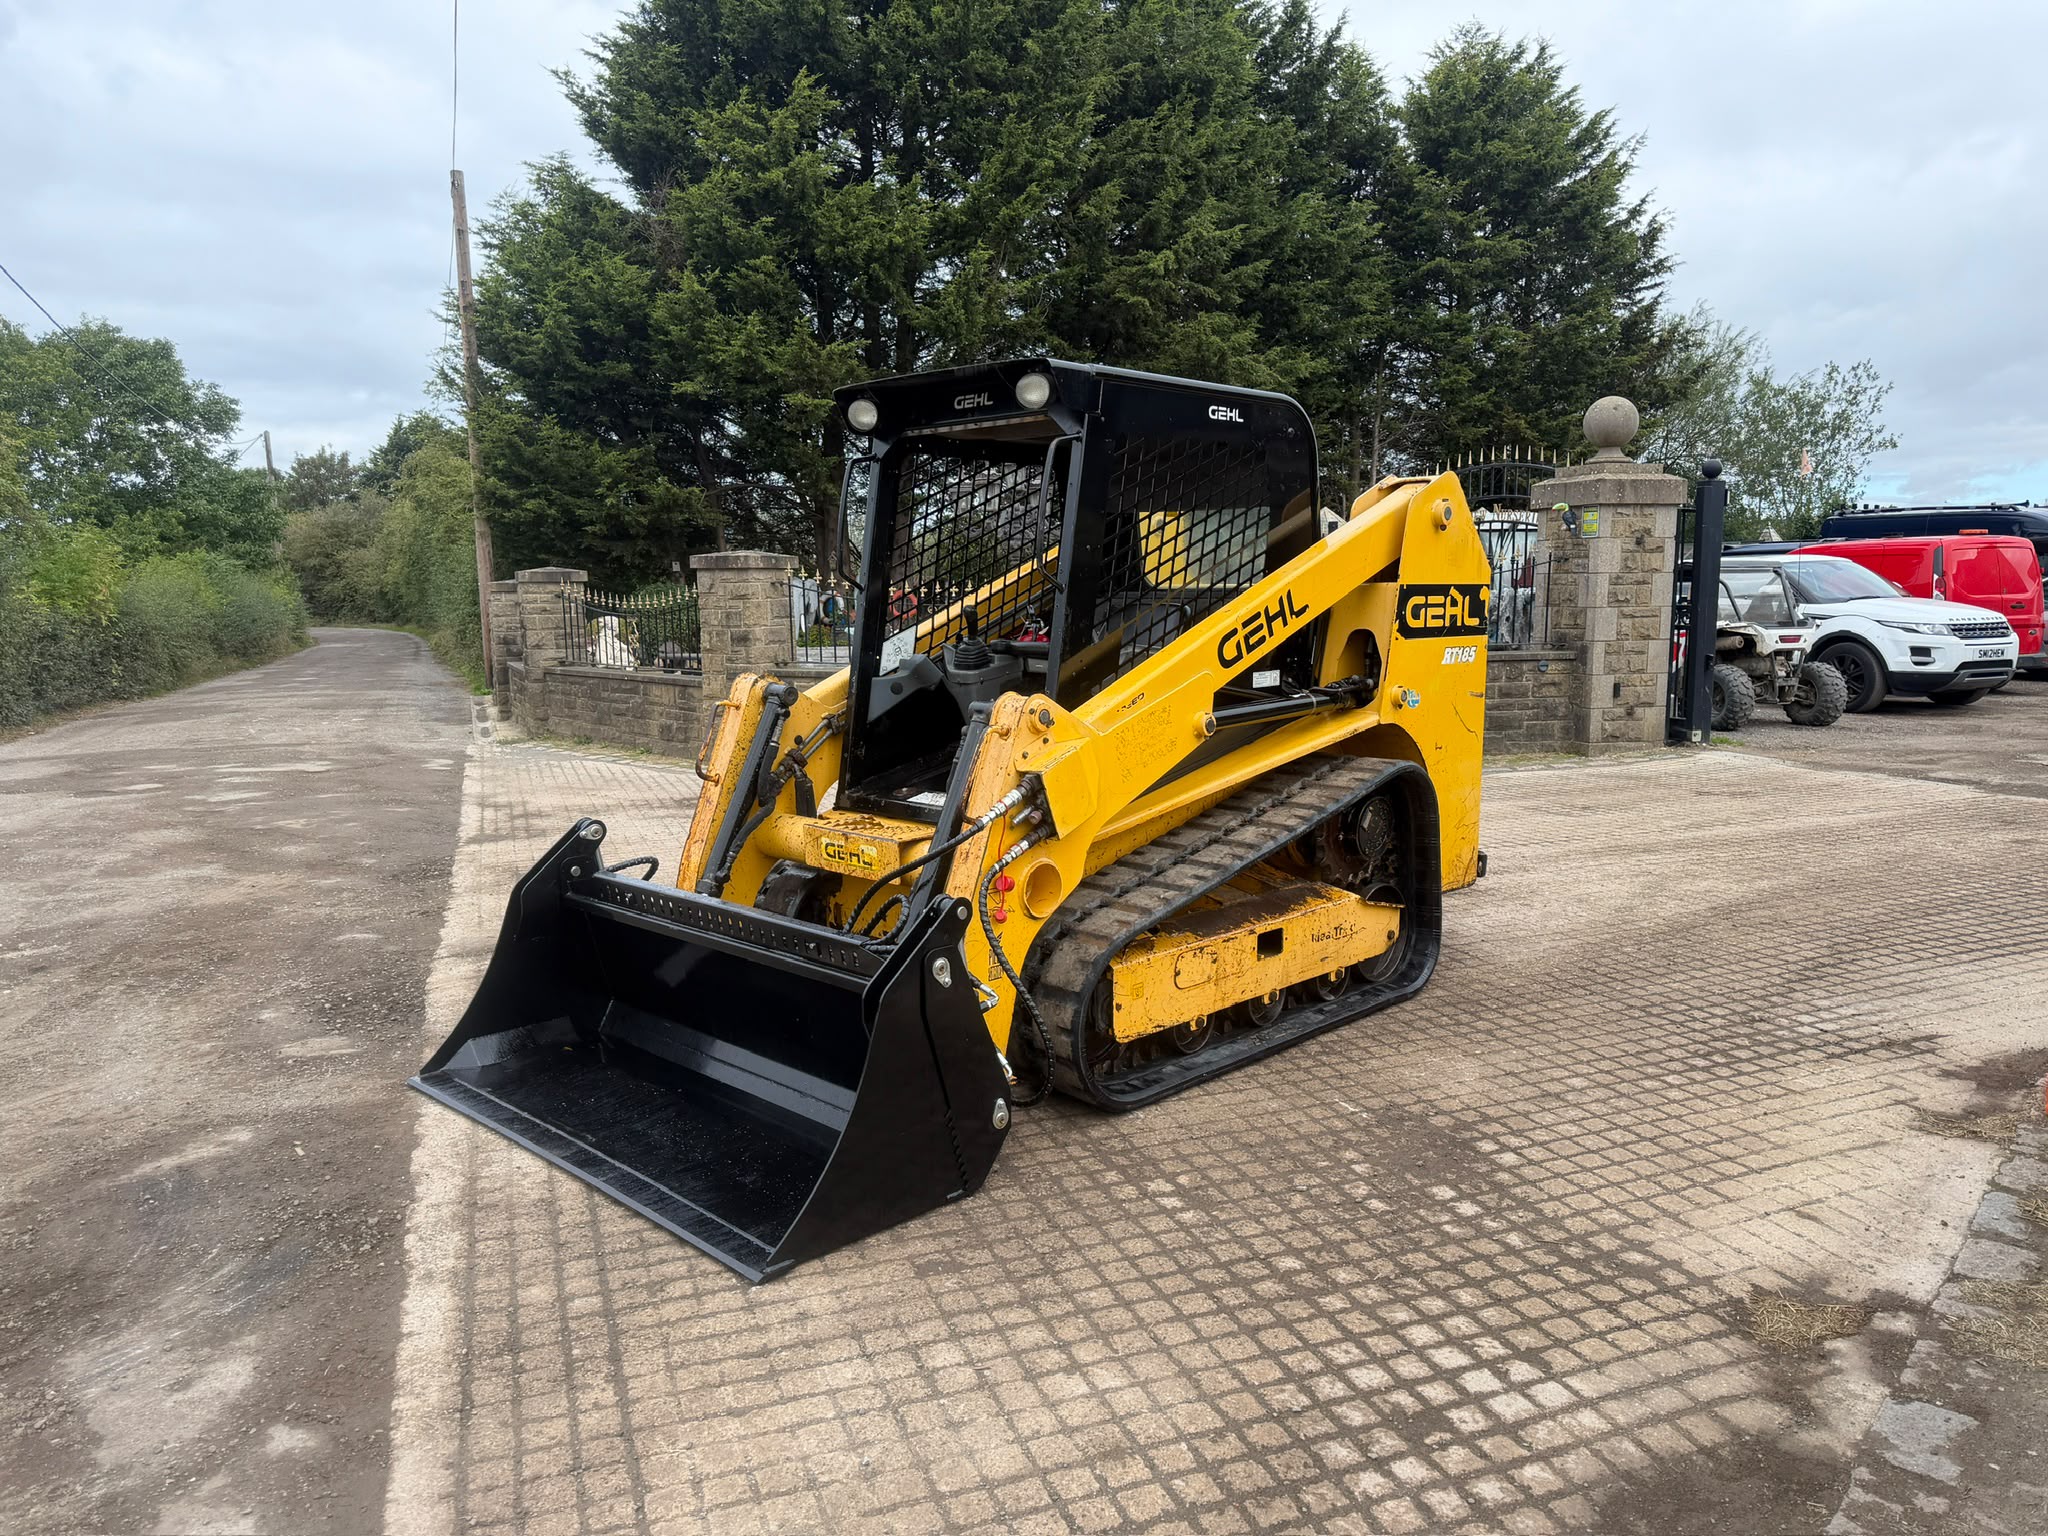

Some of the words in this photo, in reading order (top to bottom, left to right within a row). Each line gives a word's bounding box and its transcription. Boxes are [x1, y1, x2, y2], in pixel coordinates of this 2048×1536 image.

[954, 391, 994, 409] GEHL
[1208, 405, 1244, 422] GEHL
[1405, 593, 1480, 628] GEHL
[1217, 588, 1310, 669] GEHL
[1441, 645, 1478, 665] RT185
